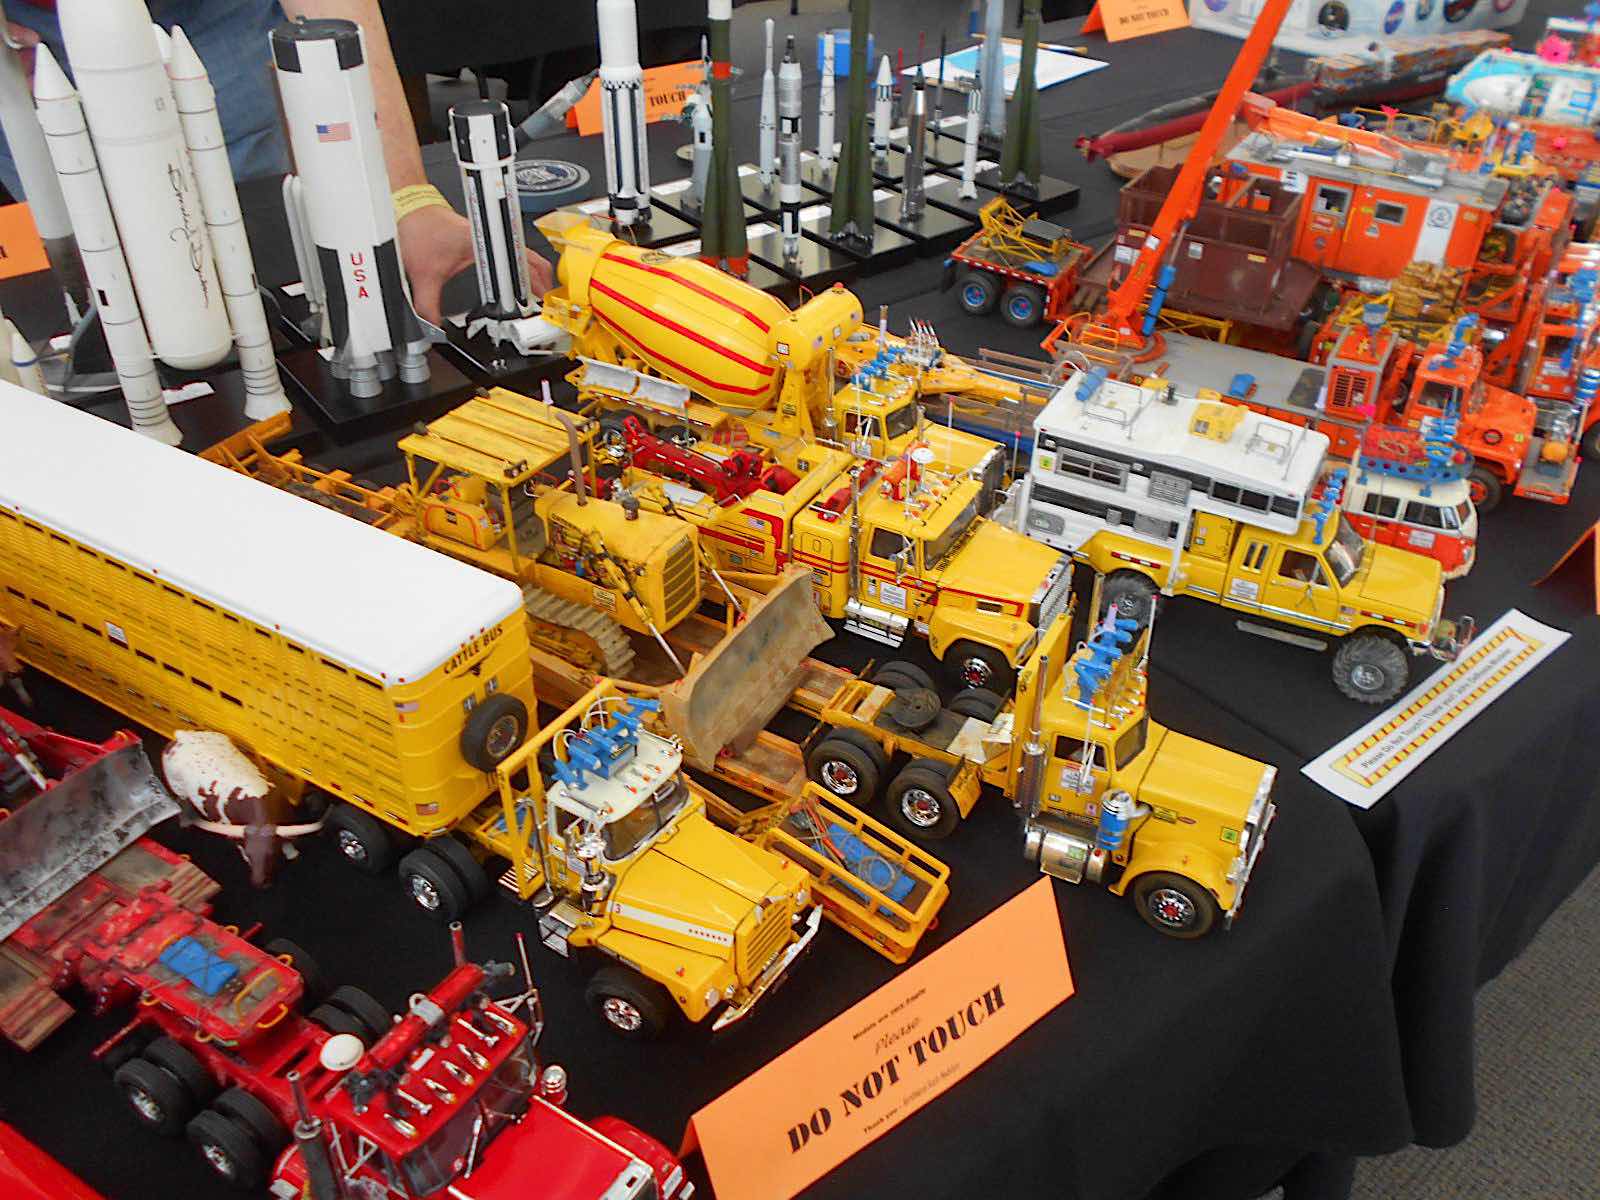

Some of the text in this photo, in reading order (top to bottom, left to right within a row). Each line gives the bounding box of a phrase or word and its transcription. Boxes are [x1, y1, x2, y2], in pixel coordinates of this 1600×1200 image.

[649, 90, 687, 108] TOUCH
[350, 251, 369, 299] USA
[443, 623, 503, 674] CATTLE BUS
[874, 1017, 921, 1056] Please
[787, 1107, 832, 1154] DO
[839, 1055, 901, 1118] NOT
[908, 984, 1005, 1067] TOUCH
